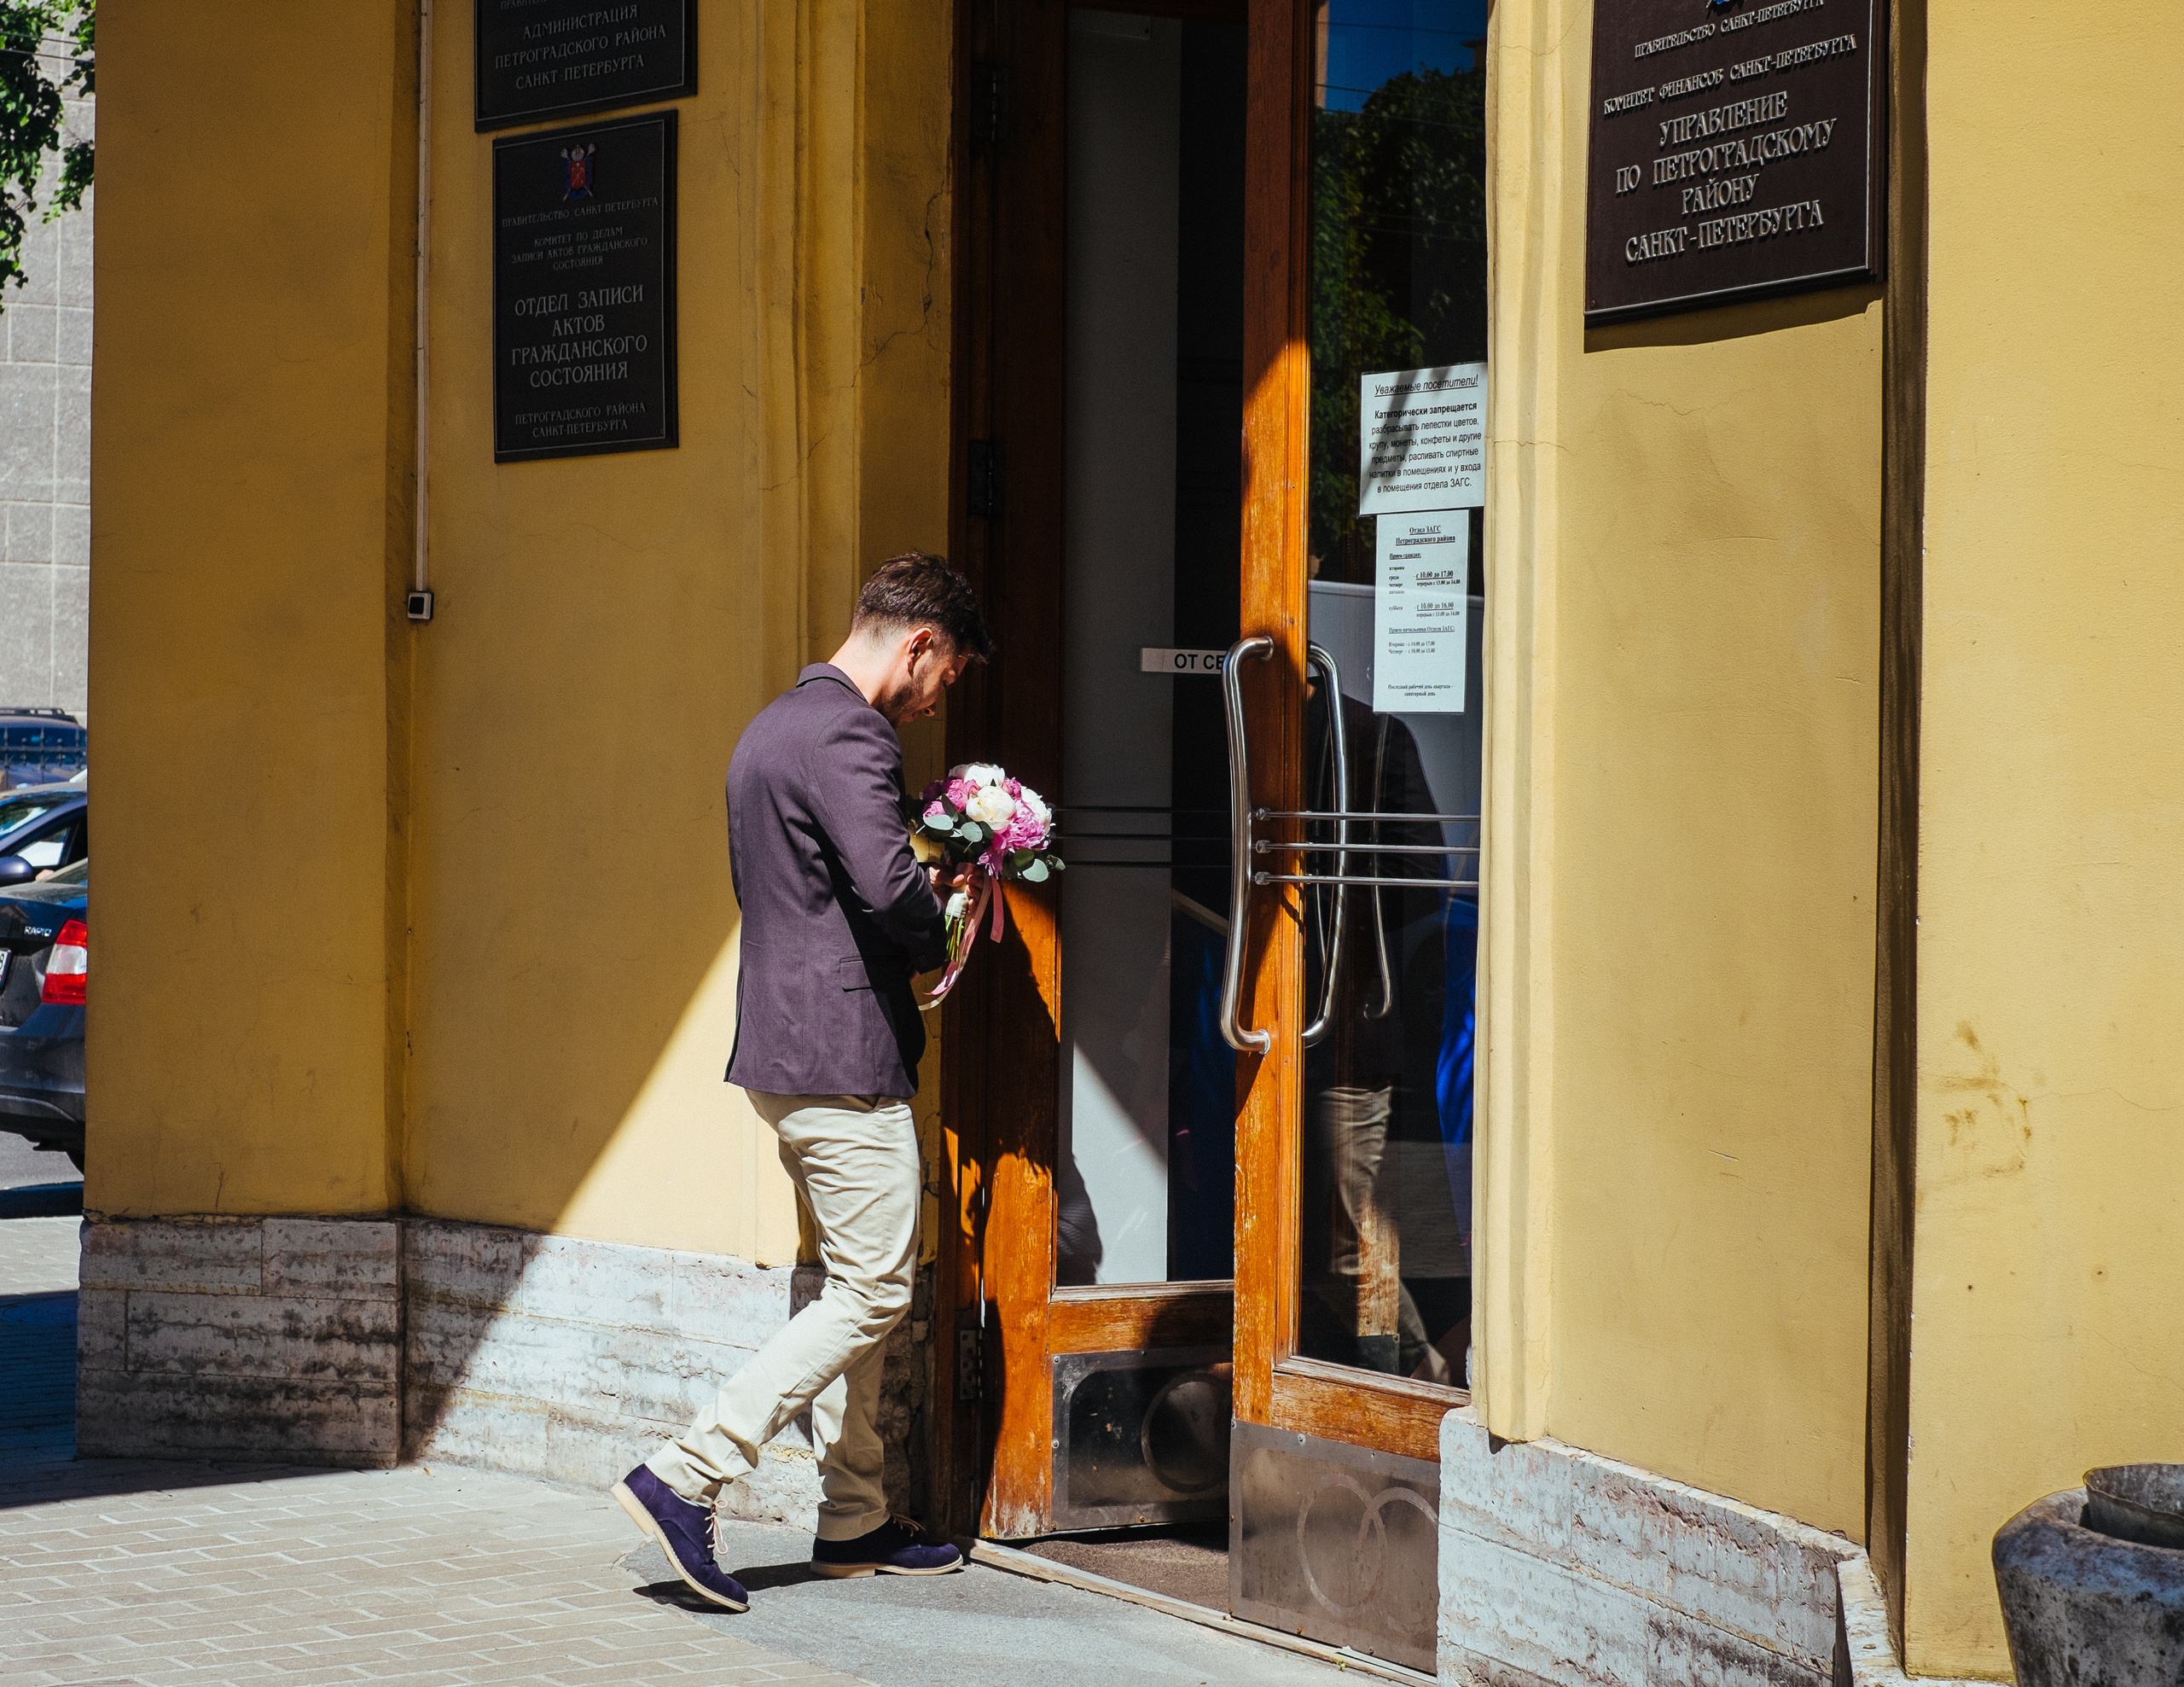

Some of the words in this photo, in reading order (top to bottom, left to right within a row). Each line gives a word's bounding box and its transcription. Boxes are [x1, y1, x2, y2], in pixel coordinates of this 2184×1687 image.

[523, 4, 638, 39] АДМИНИСТРАЦИЯ
[495, 36, 609, 69] ПЕТРОГРАДСКОГО
[615, 24, 666, 46] РАЙОНА
[1635, 23, 1716, 58] ПРАВИТЕЛЬСТВО
[1604, 86, 1655, 115] КОМИТЕТ
[1658, 67, 1723, 99] ФИНАНСОВ
[1729, 33, 1857, 80] САНКТ-ПЕТЕРБУРГА
[1659, 90, 1788, 147] УПРАВЛЕНИЕ
[1615, 164, 1641, 194] ПО
[1652, 118, 1838, 185] ПЕТРОГРАДСКОМУ
[1681, 173, 1760, 215] РАЙОНУ
[502, 209, 570, 228] ПРАВИТЕЛЬСТВО
[534, 233, 572, 247] КОМИТЕТ
[577, 231, 589, 241] ПО
[592, 226, 624, 240] ДЕЛАМ
[1624, 199, 1824, 263] САНКТ-ПЕТЕРБУРГА
[511, 251, 543, 264] ЗАПИСИ
[547, 246, 574, 259] АКТОВ
[578, 236, 648, 254] ГРАЖДАНСКОГО
[553, 255, 603, 271] СОСТОЯНИЯ
[514, 294, 569, 317] ОТДЕЛ
[578, 284, 644, 309] ЗАПИСИ
[552, 314, 605, 337] АКТОВ
[512, 334, 648, 365] ГРАЖДАНСКОГО
[530, 361, 629, 387] СОСТОЯНИЯ
[1374, 382, 1421, 395] Уважаемые
[1423, 374, 1478, 390] посетители!
[515, 406, 601, 425] ПЕТРОГРАДСКОГО
[607, 402, 646, 416] РАЙОНА
[1374, 407, 1428, 419] Категорически
[1429, 402, 1478, 416] запрещается
[532, 419, 628, 438] САНКТ-ПЕТЕРБУРГА
[1371, 422, 1420, 435] разбрасывать
[1420, 421, 1452, 430] лепестки
[1453, 417, 1479, 428] цветов,
[1368, 441, 1390, 451] крупу,
[1391, 439, 1419, 448] монеты,
[1420, 434, 1451, 446] конфеты
[1458, 432, 1482, 443] другие
[1371, 454, 1407, 465] предметы,
[1409, 451, 1444, 462] распивать
[1445, 447, 1479, 459] спиртные
[1368, 468, 1396, 479] напитки
[1403, 465, 1447, 476] помещениях
[1454, 465, 1459, 474] у
[1460, 462, 1481, 472] входа
[1382, 483, 1422, 493] помещения
[1423, 480, 1449, 490] отдела
[1449, 477, 1472, 488] ЗАГС.
[1396, 536, 1436, 545] Петроградского
[1174, 653, 1199, 669] ОТ
